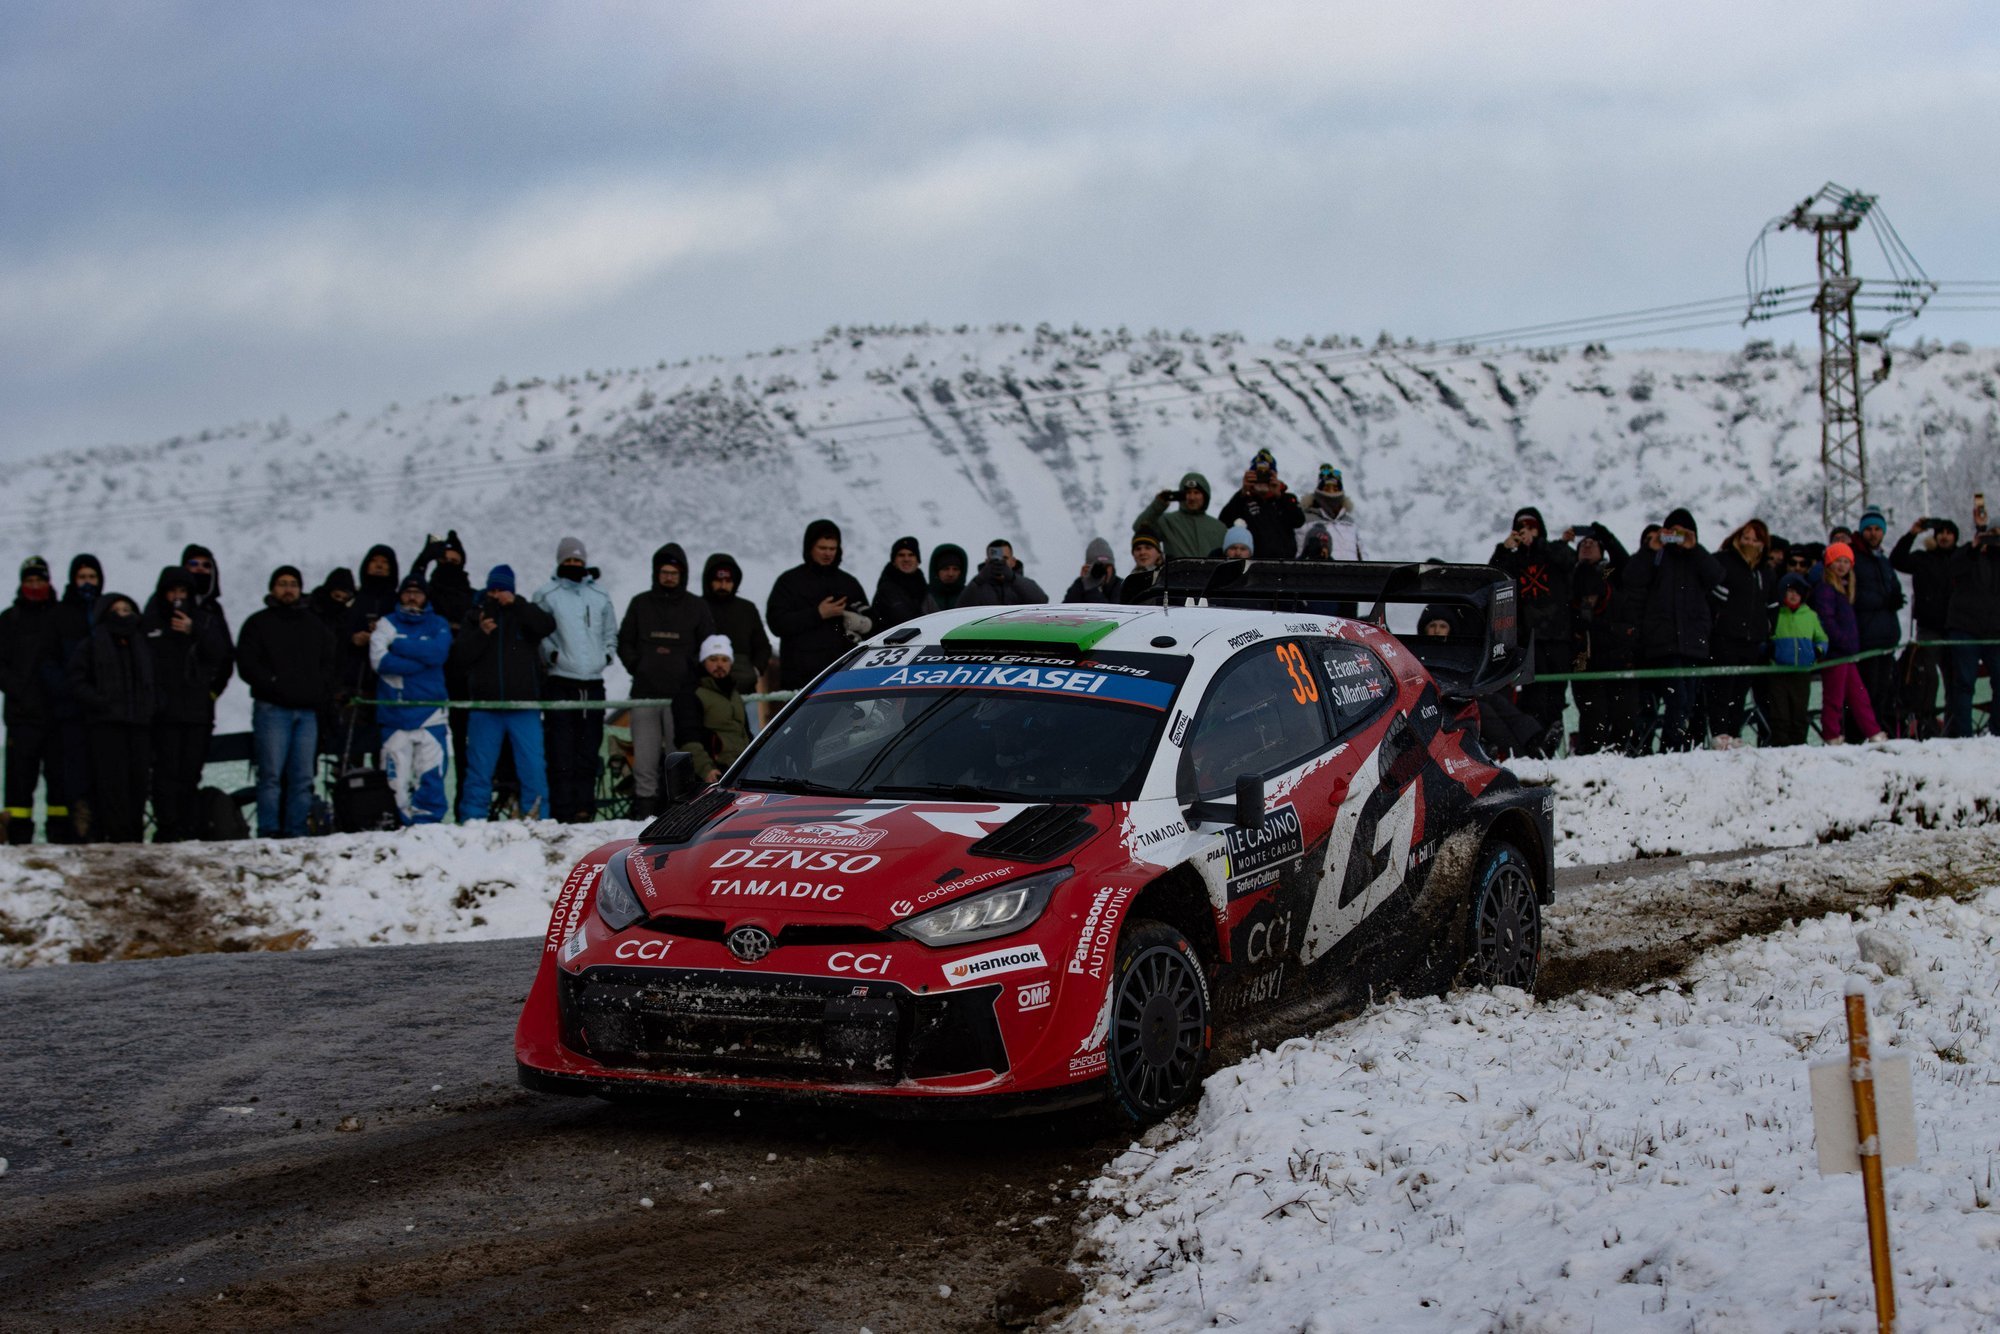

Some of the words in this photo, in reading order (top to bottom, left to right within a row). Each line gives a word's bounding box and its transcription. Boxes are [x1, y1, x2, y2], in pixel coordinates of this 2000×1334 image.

[1227, 628, 1264, 650] PROTERIAL
[865, 648, 911, 667] 33
[916, 654, 995, 664] TOYOTA
[999, 654, 1077, 667] GAZOO
[1078, 659, 1151, 677] Racing
[880, 667, 1109, 693] AsahiKASEI
[1275, 643, 1320, 705] 33
[1323, 660, 1361, 680] E.Evans
[1331, 681, 1370, 707] S.Martin
[1420, 704, 1438, 720] KINTO
[1172, 714, 1189, 746] CENTRAL
[760, 832, 797, 844] RALLYE
[1138, 821, 1186, 847] TAMADIC
[1228, 831, 1246, 855] LE
[1246, 812, 1298, 849] CASINO
[709, 849, 882, 874] DENSO
[1206, 847, 1226, 862] PIAA
[710, 880, 845, 901] TAMADIC
[918, 867, 1013, 904] codebeamer
[1236, 869, 1281, 893] SafetyCulture
[546, 863, 589, 952] AUTOMOTIVE
[1068, 886, 1114, 975] Panasonic
[1089, 886, 1132, 979] AUTOMOTIVE
[615, 939, 674, 960] CCi
[827, 951, 893, 974] CCi
[1018, 985, 1051, 1007] OMP
